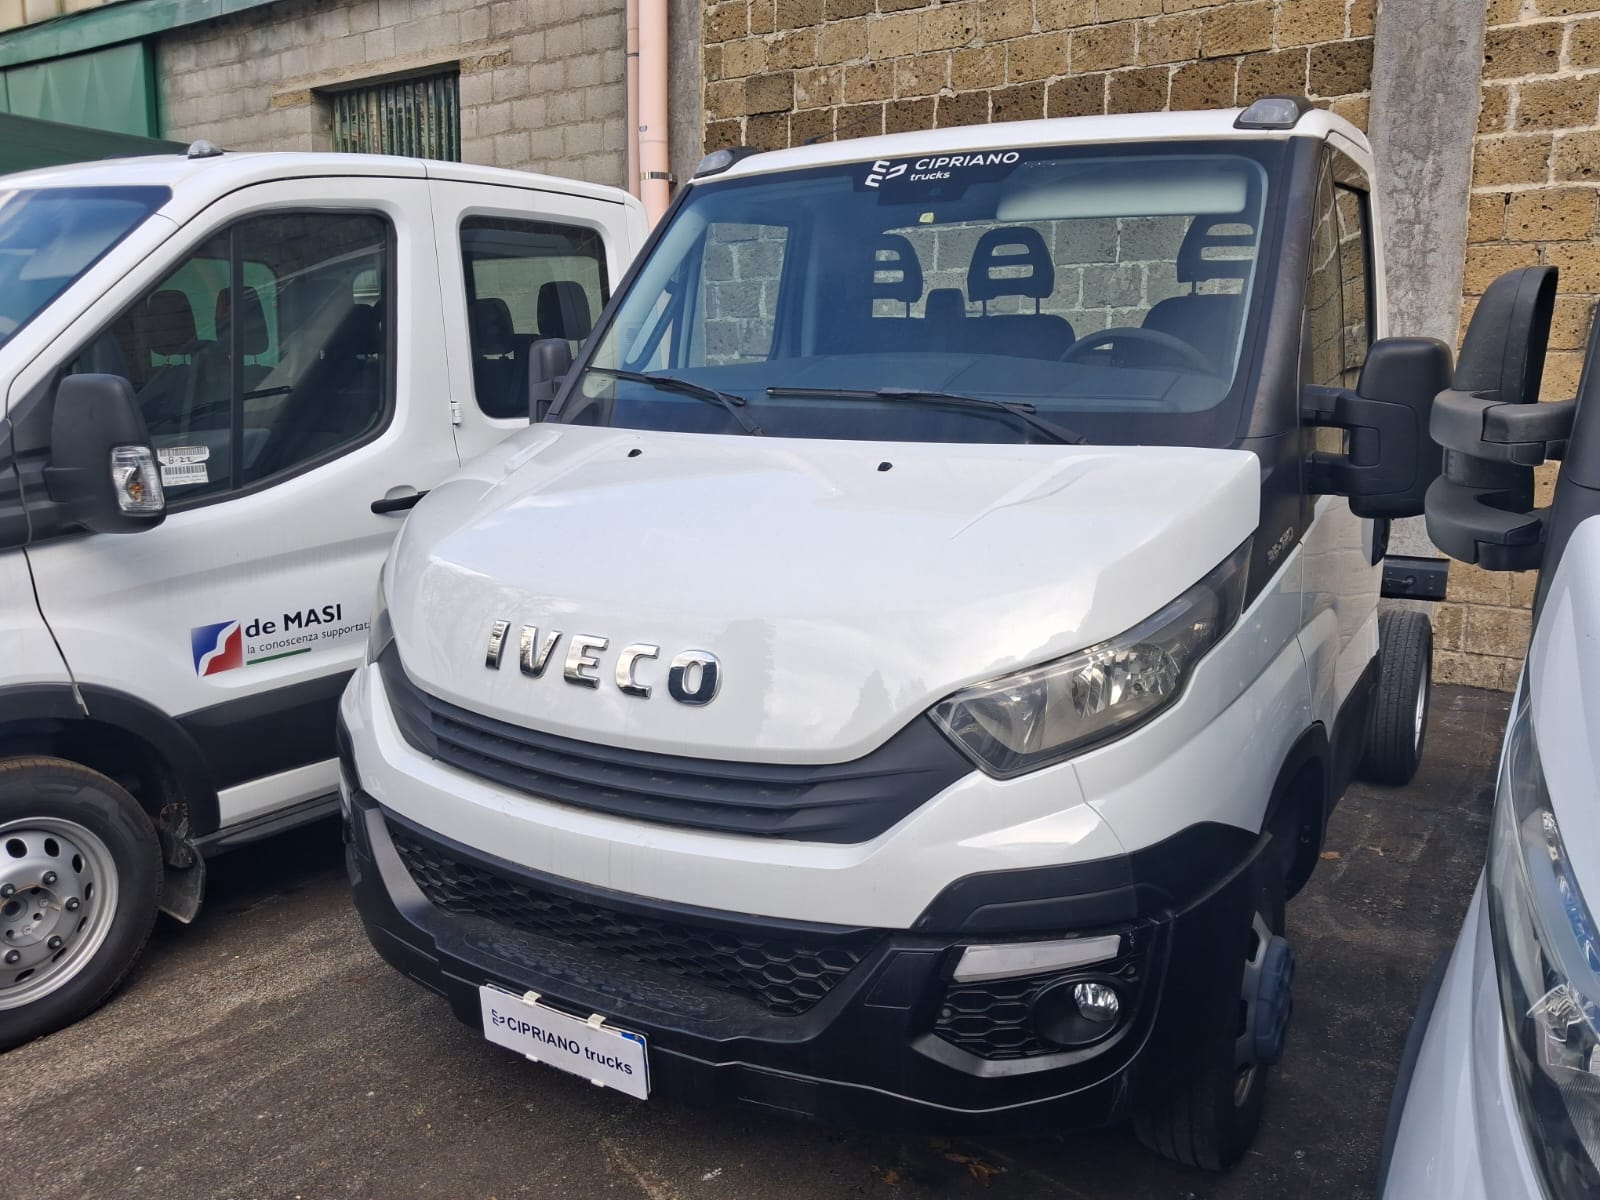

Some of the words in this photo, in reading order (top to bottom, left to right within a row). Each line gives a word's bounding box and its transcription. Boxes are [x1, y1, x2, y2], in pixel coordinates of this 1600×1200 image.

[910, 170, 951, 181] trucks
[915, 152, 1020, 170] CIPRIANO
[245, 618, 276, 638] de
[283, 603, 342, 631] MASI
[247, 645, 256, 654] la
[259, 633, 319, 652] conoscenza
[321, 621, 371, 639] supportat
[485, 619, 723, 707] IVECO
[507, 1017, 580, 1055] CIPRIANO
[585, 1047, 633, 1075] trucks
